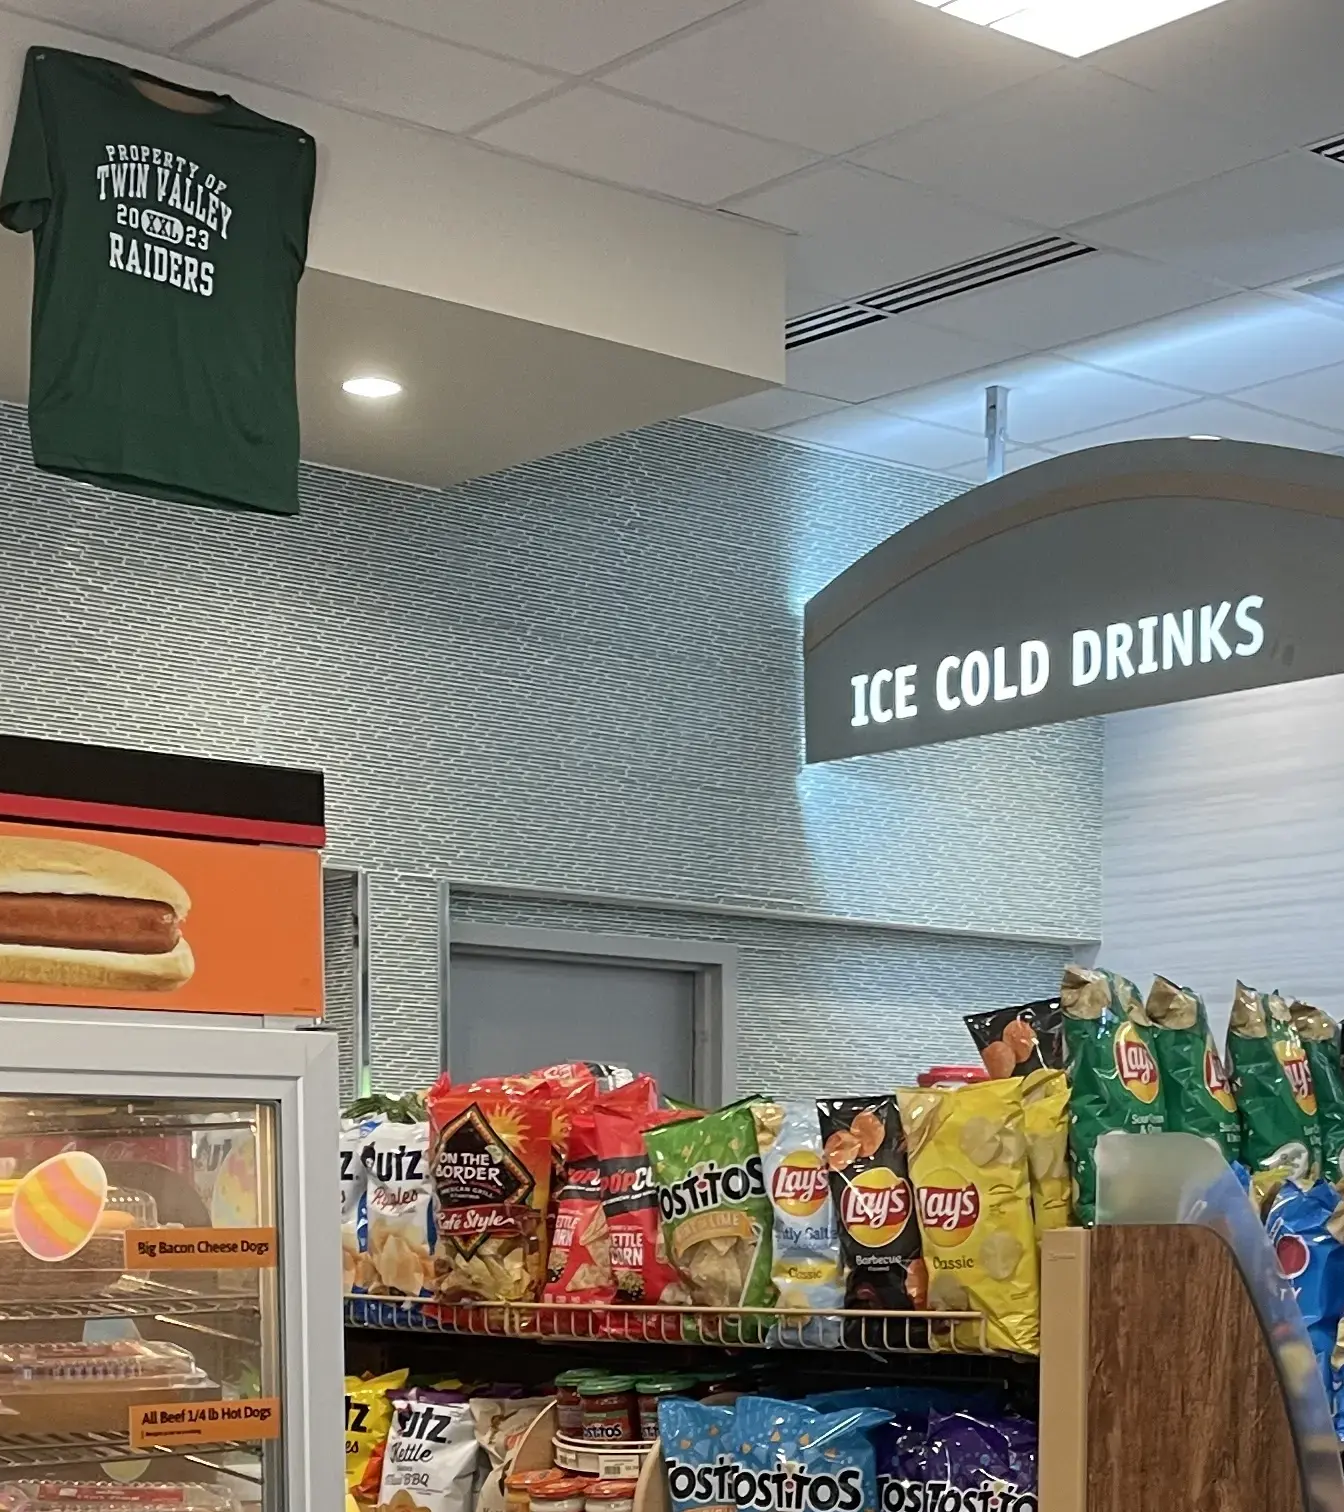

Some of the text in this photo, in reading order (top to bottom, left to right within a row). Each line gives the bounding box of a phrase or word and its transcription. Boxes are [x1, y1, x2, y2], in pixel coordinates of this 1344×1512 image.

[106, 144, 227, 195] PROPERTY OF
[96, 162, 233, 241] TWIN VALLEY
[117, 203, 209, 251] 20 XXL 23
[109, 231, 215, 297] RAIDERS
[850, 594, 1266, 728] ICE COLD DRINKS
[436, 1164, 504, 1187] BORDER
[439, 1152, 490, 1166] ON THE
[659, 1156, 766, 1220] OSTITOS
[774, 1165, 829, 1203] Lay's
[463, 1209, 515, 1233] Style
[845, 1181, 906, 1230] Lay's
[918, 1184, 976, 1231] Lay's
[137, 1240, 269, 1257] Big Bacon Cheese Dogs
[855, 1254, 903, 1267] Barbecue
[932, 1255, 975, 1271] Classic
[142, 1406, 272, 1426] All Beef 1/4 lb Hot Dogs
[390, 1441, 434, 1464] Kettle
[403, 1472, 430, 1488] BBQ
[733, 1463, 861, 1509] OSTITOS
